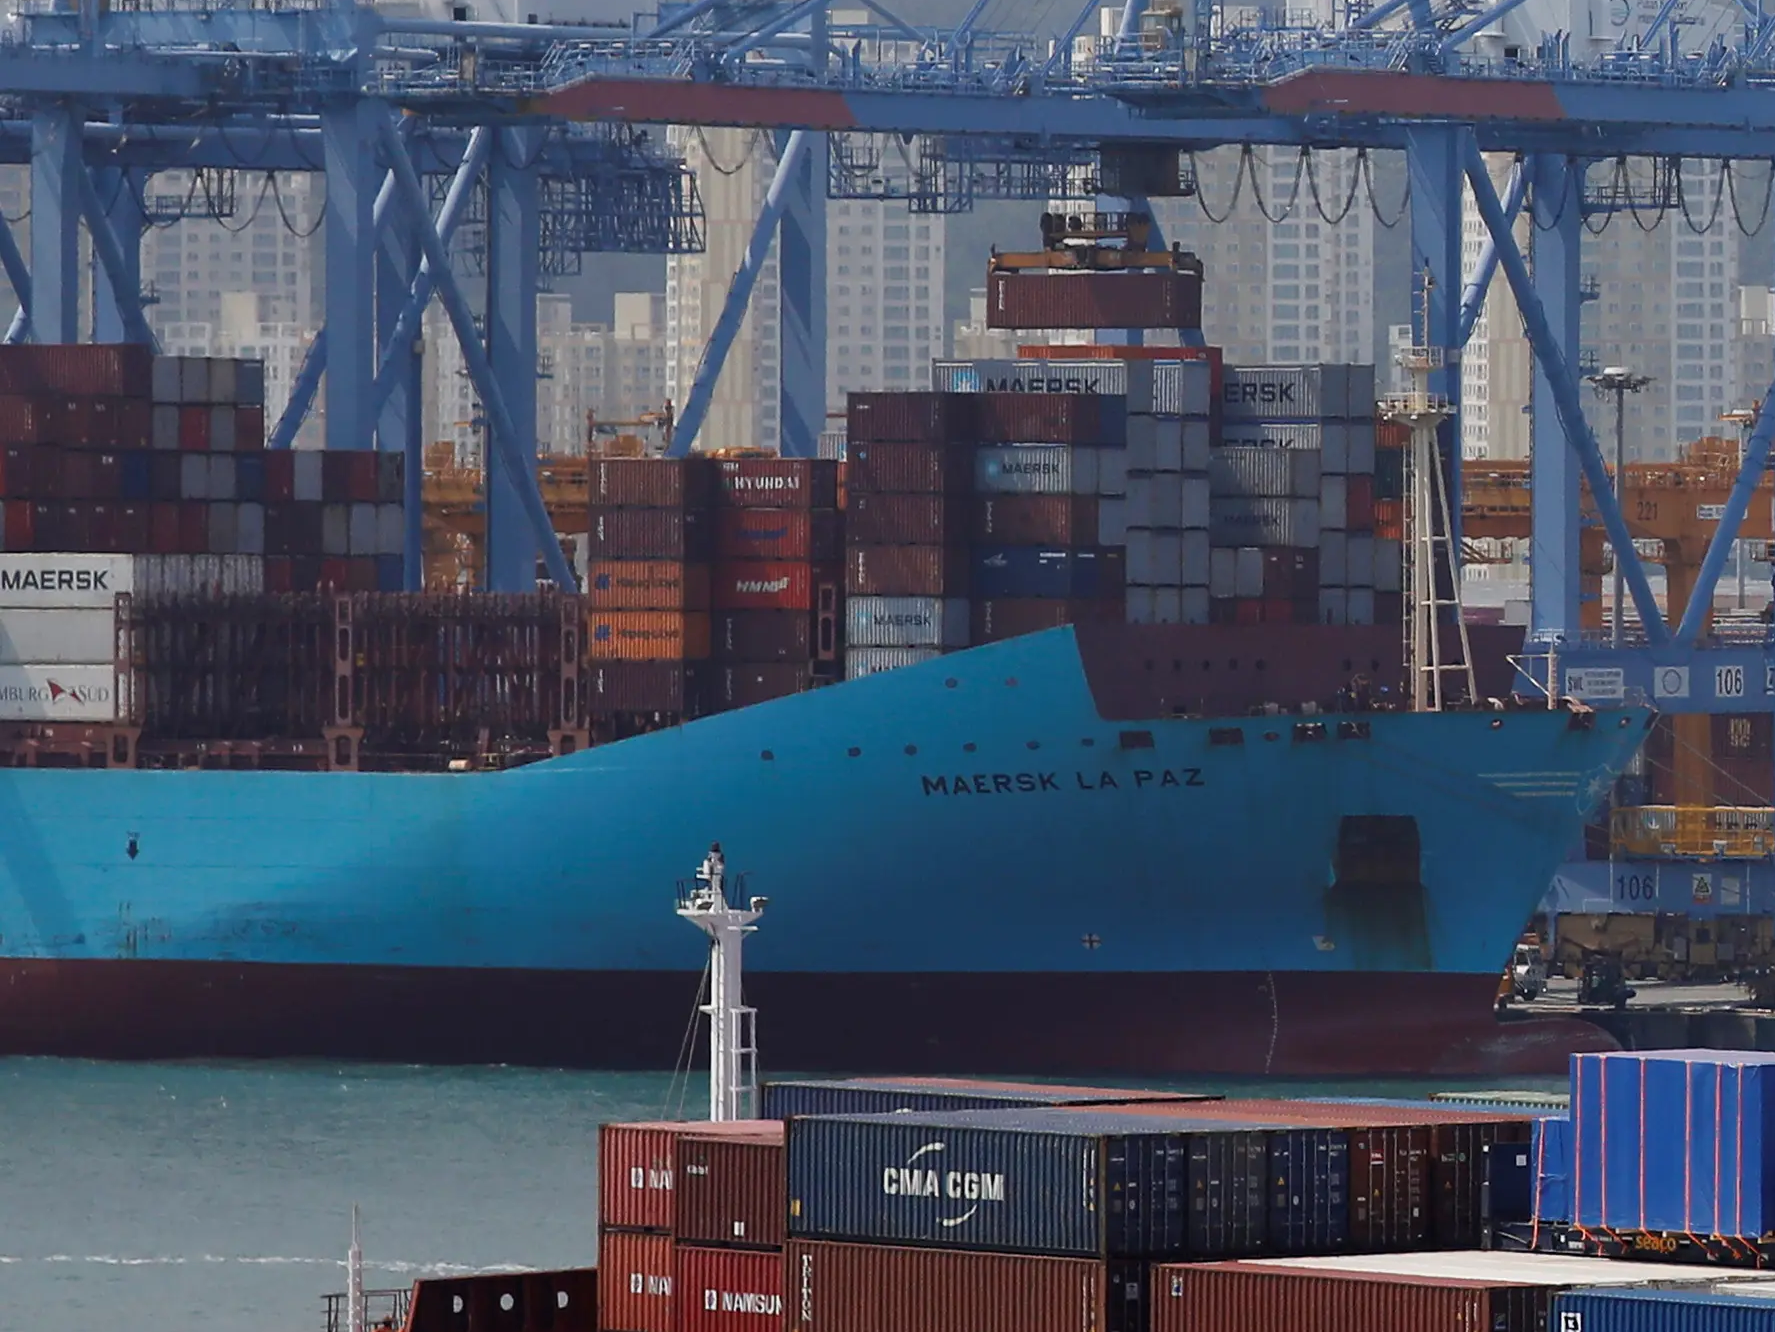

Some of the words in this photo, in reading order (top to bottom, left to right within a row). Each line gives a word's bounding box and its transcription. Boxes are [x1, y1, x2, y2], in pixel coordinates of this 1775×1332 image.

[1002, 463, 1060, 474] MAERSK
[1637, 502, 1658, 521] 221
[1, 569, 109, 590] MAERSK
[874, 614, 932, 627] MAERSK
[1716, 669, 1742, 695] 106
[922, 772, 1063, 796] MAERSK
[1076, 771, 1120, 790] LA
[1134, 768, 1206, 788] PAZ
[1617, 875, 1654, 901] 106
[883, 1167, 939, 1198] CMA
[946, 1171, 1005, 1202] CGM
[1634, 1235, 1677, 1252] seaco
[801, 1254, 812, 1321] TRITON
